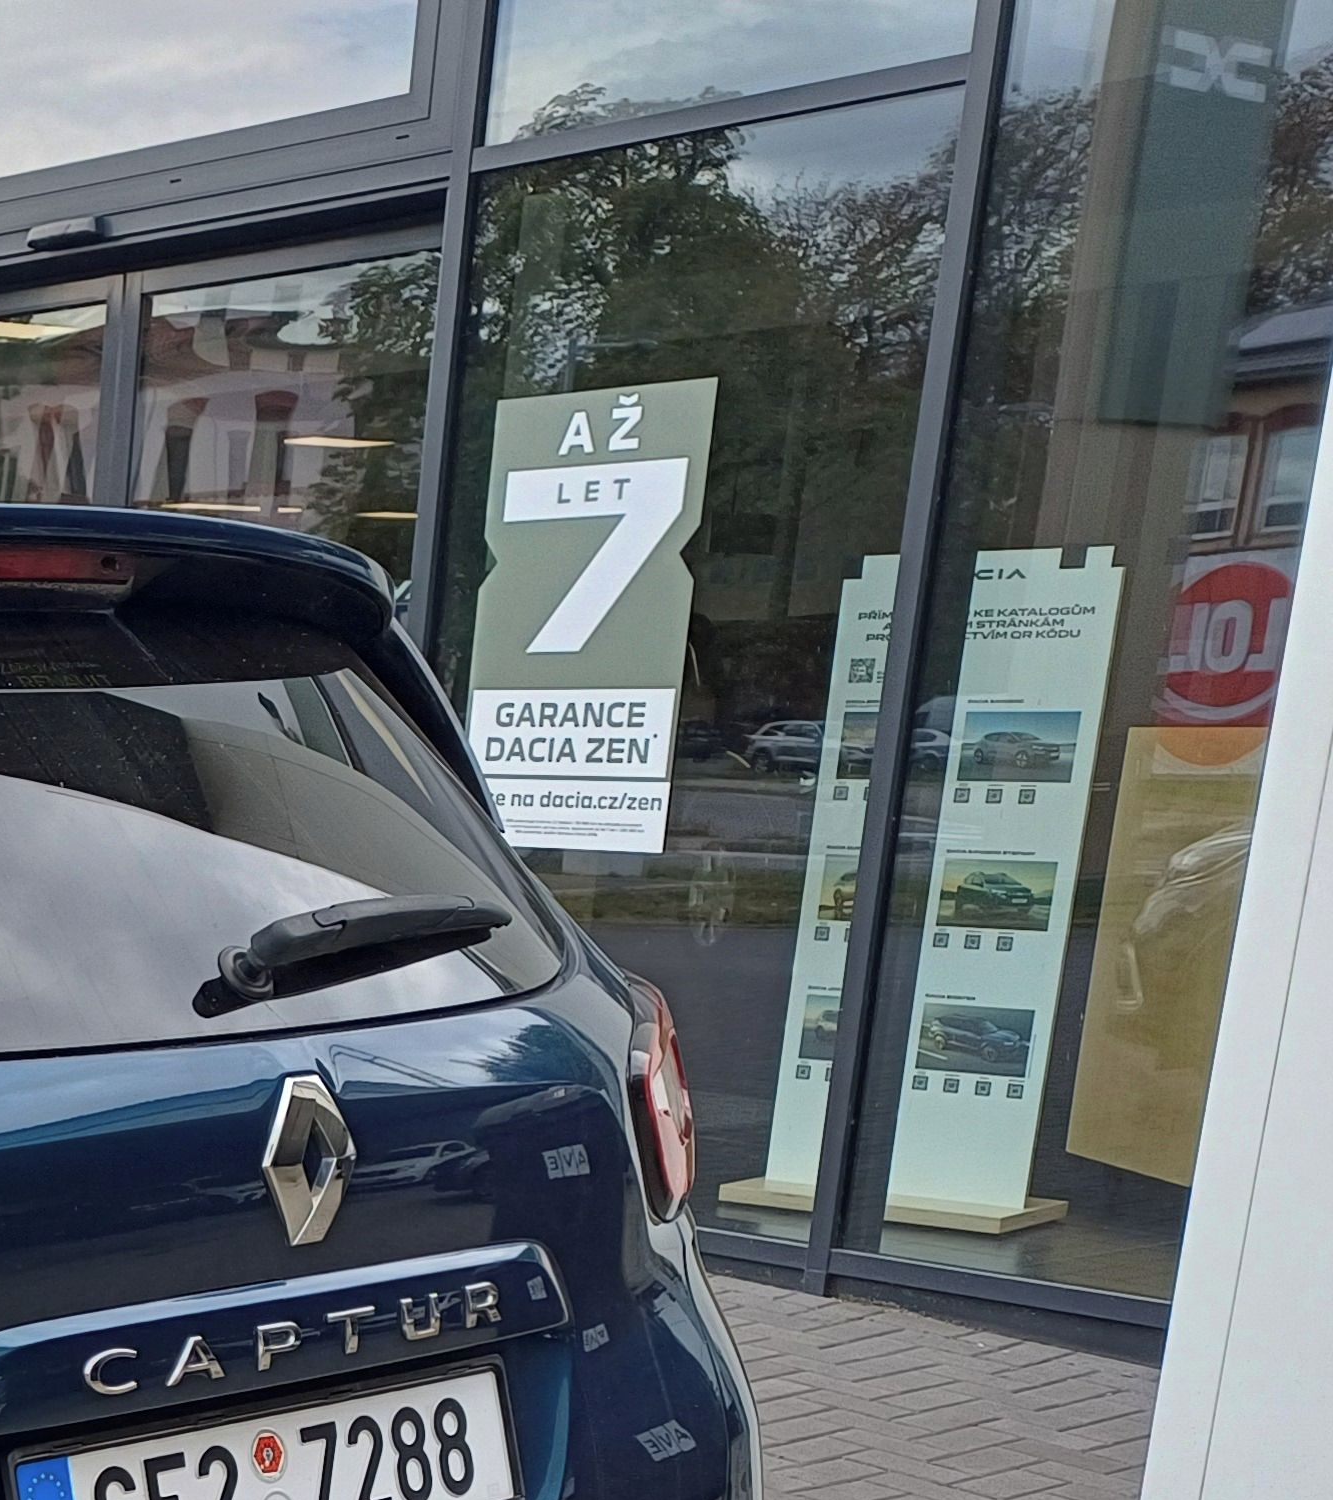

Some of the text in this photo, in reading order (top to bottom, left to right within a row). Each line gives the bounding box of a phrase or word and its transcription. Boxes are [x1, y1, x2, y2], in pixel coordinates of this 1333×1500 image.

[558, 393, 643, 456] AŽ
[557, 478, 631, 504] LET
[503, 457, 689, 654] 7
[974, 568, 1027, 581] CIA
[974, 608, 995, 618] KE
[495, 701, 648, 729] GARANCE
[484, 736, 578, 763] DACIA
[510, 792, 535, 808] na
[539, 790, 663, 813] dacia.cz/zen
[83, 1281, 502, 1395] CAPTUR
